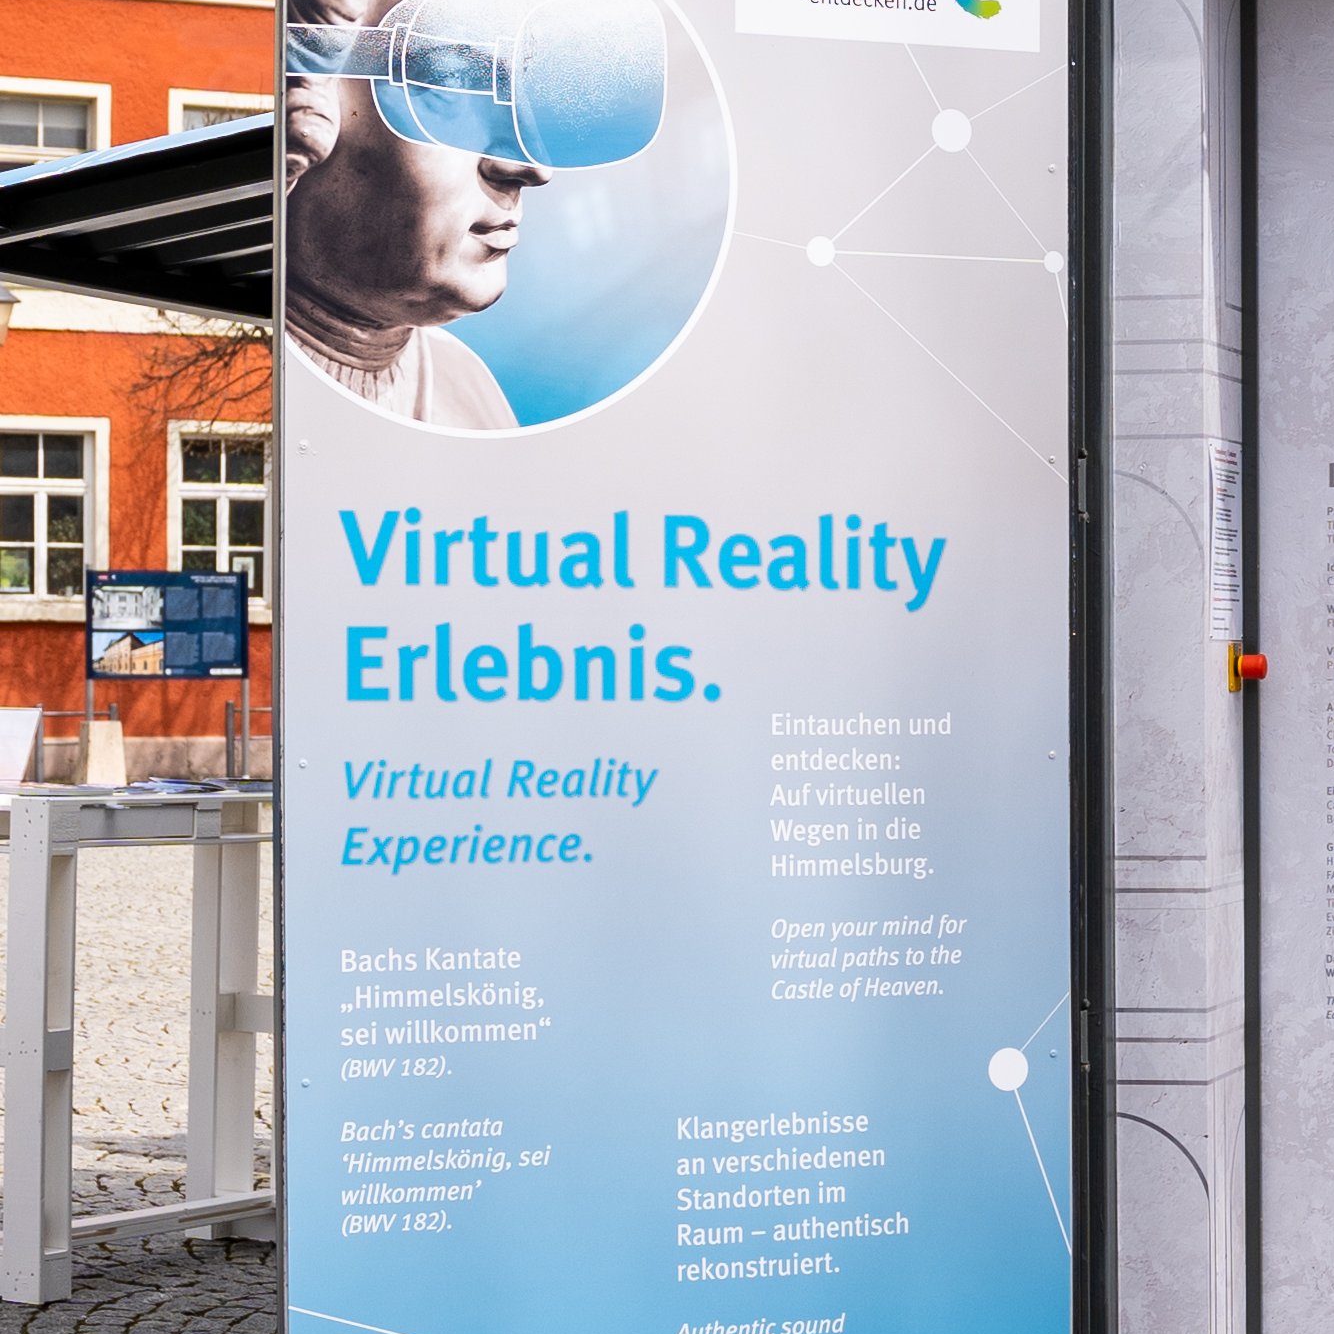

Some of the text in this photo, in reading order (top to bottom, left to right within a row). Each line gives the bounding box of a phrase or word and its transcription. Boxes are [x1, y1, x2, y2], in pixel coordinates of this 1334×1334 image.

[339, 507, 946, 612] Virtual Reality
[347, 623, 720, 702] Erlebnis.
[772, 712, 951, 735] Eintauchen und
[772, 748, 899, 770] entdecken:
[345, 758, 657, 807] Virtual Reality
[770, 783, 924, 806] Auf virtuellen
[771, 817, 920, 846] Wegen in die
[342, 825, 592, 875] Experience.
[772, 852, 934, 879] Himmelsburg.
[342, 948, 520, 972] Bachs Kantate
[341, 1022, 376, 1046] sei
[341, 1056, 451, 1081] (BWV 182).
[422, 1118, 503, 1138] cantata
[678, 1111, 868, 1142] Klangerlebnisse
[519, 1145, 551, 1166] sei
[677, 1146, 884, 1175] an verschiedenen
[678, 1181, 845, 1211] Standorten im
[342, 1210, 451, 1237] (BWV 182).
[678, 1224, 742, 1246] Raum
[774, 1212, 908, 1241] authentisch
[678, 1253, 840, 1282] rekonstruiert.
